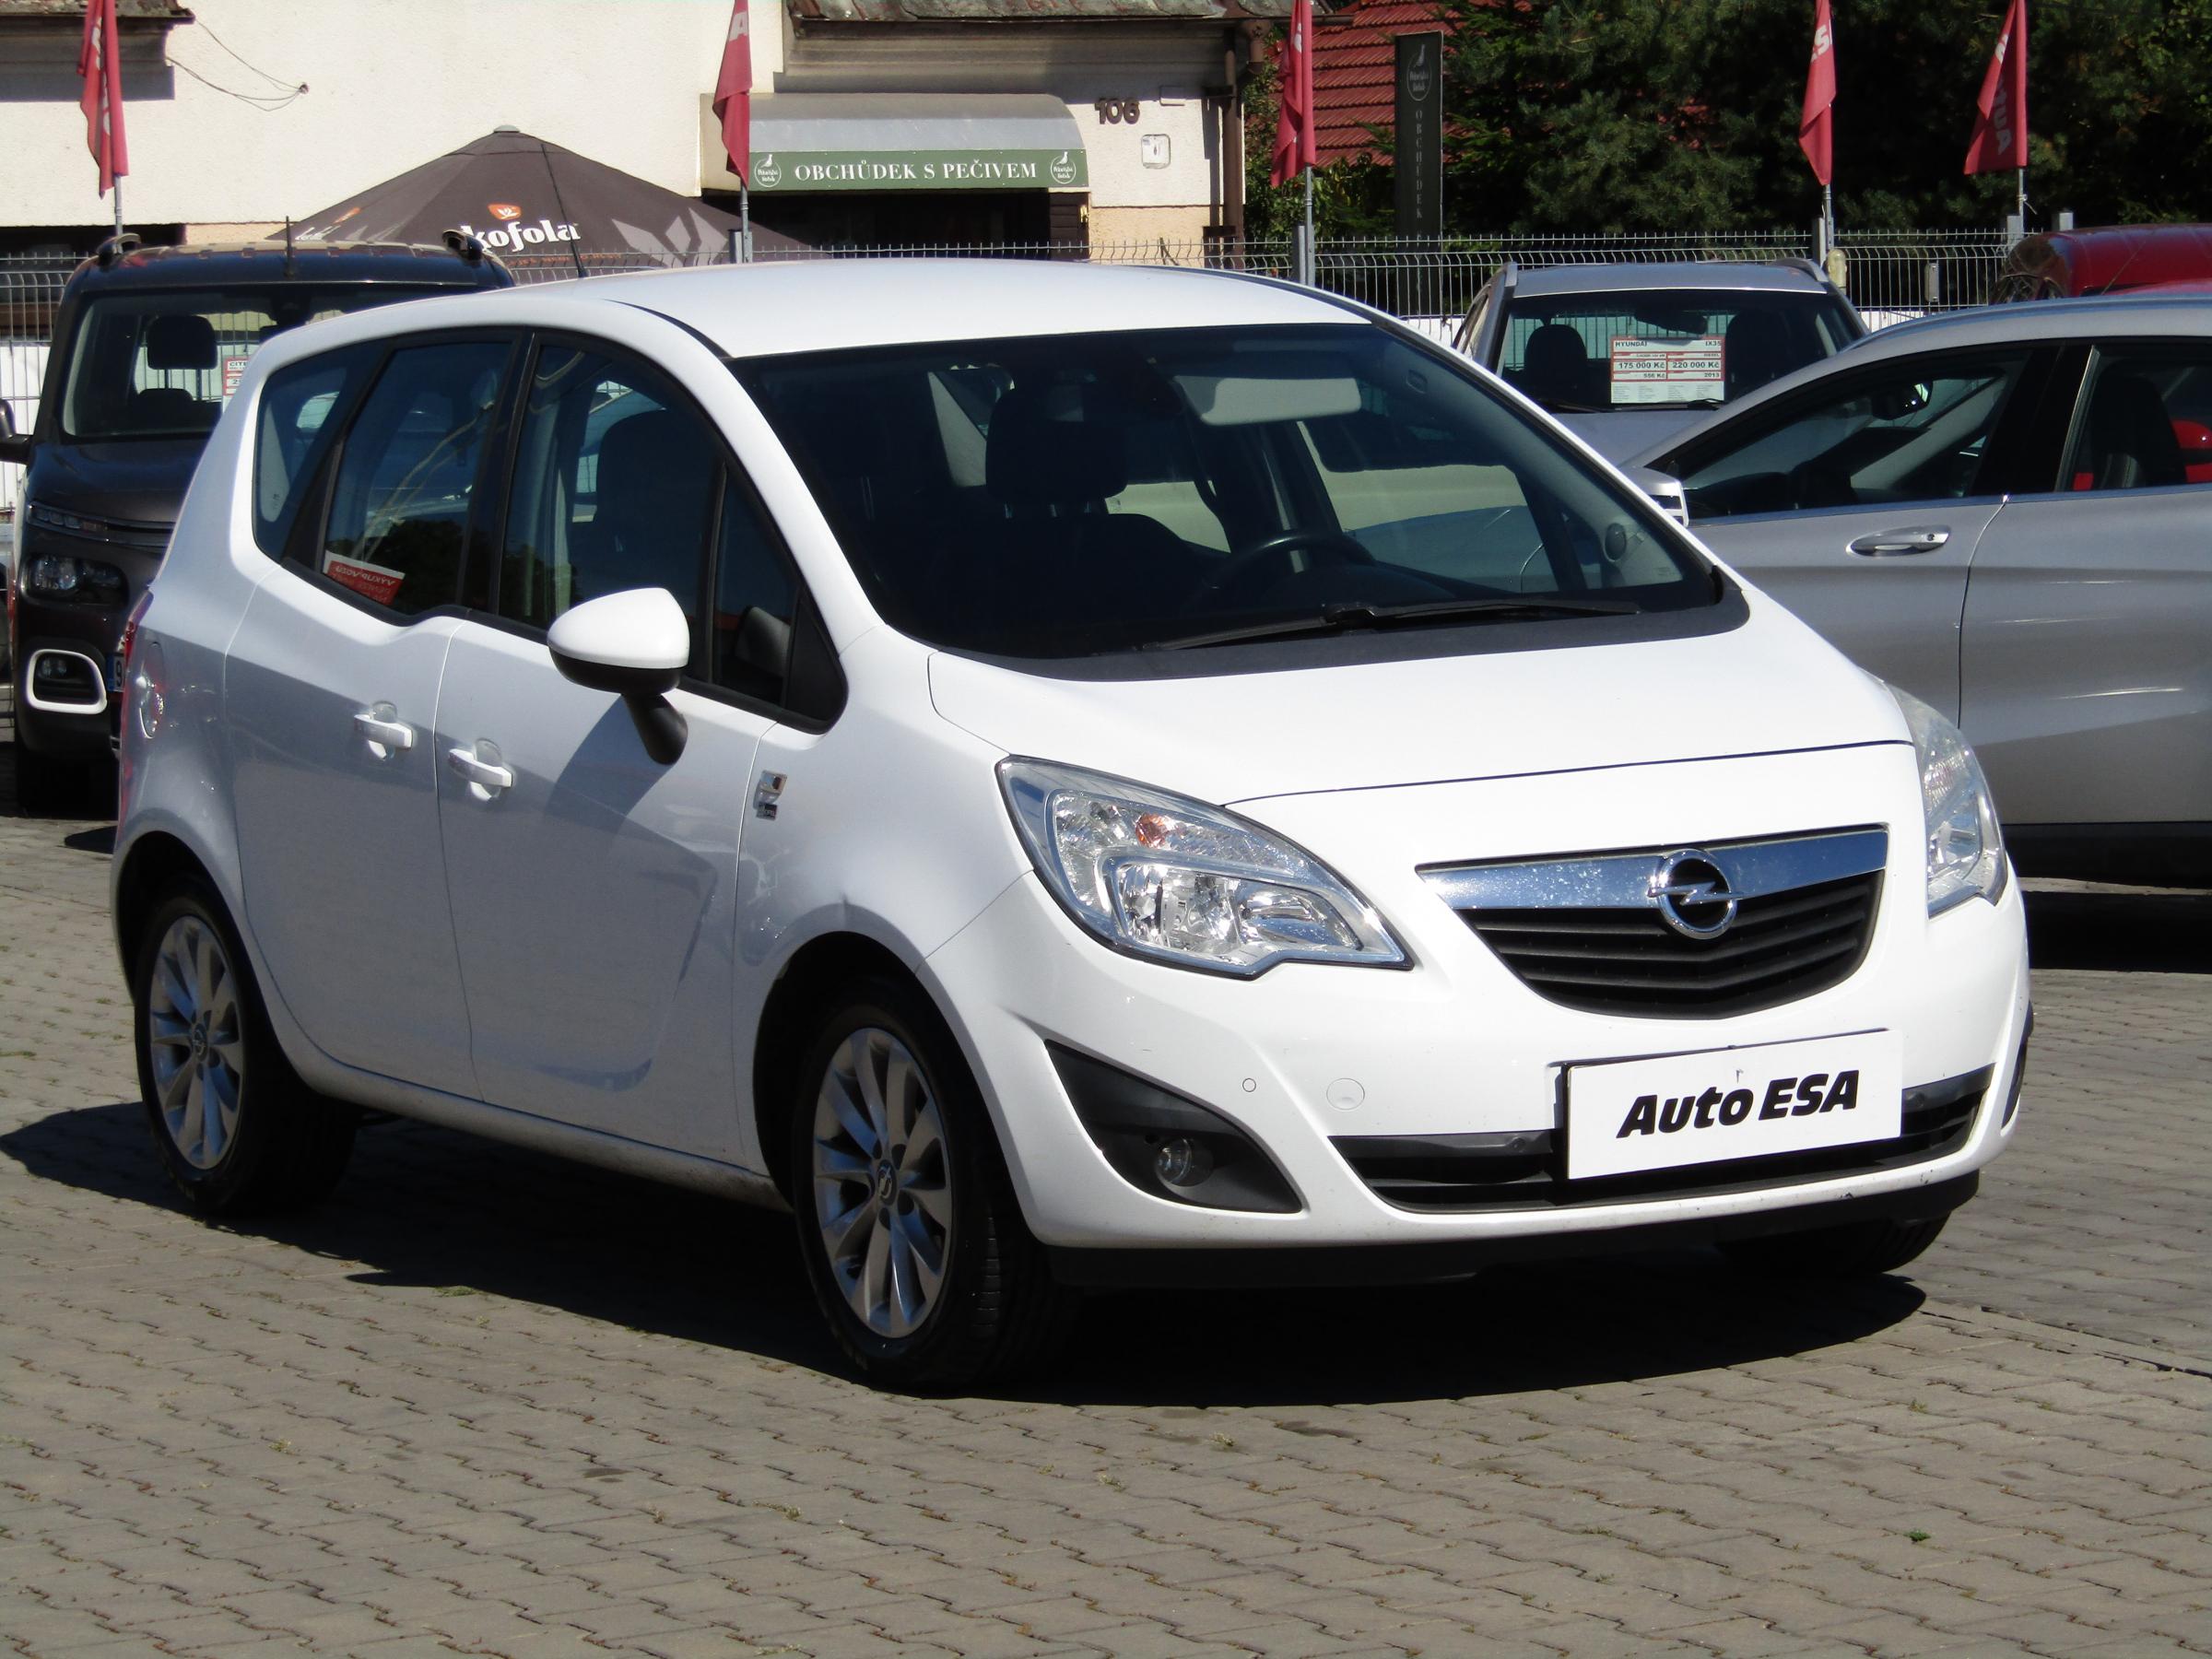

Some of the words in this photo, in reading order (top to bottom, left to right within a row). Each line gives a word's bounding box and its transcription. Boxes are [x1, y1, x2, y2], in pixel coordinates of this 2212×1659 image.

[1094, 98, 1140, 124] 106
[794, 159, 917, 182] OBCHŮDEK
[924, 163, 935, 180] S
[943, 159, 1037, 179] PEČIVEM
[1618, 361, 1633, 370] 175
[1636, 361, 1652, 370] 000
[1708, 360, 1720, 369] Kč
[1616, 1087, 1754, 1139] Auto
[1759, 1069, 1860, 1121] ESA
